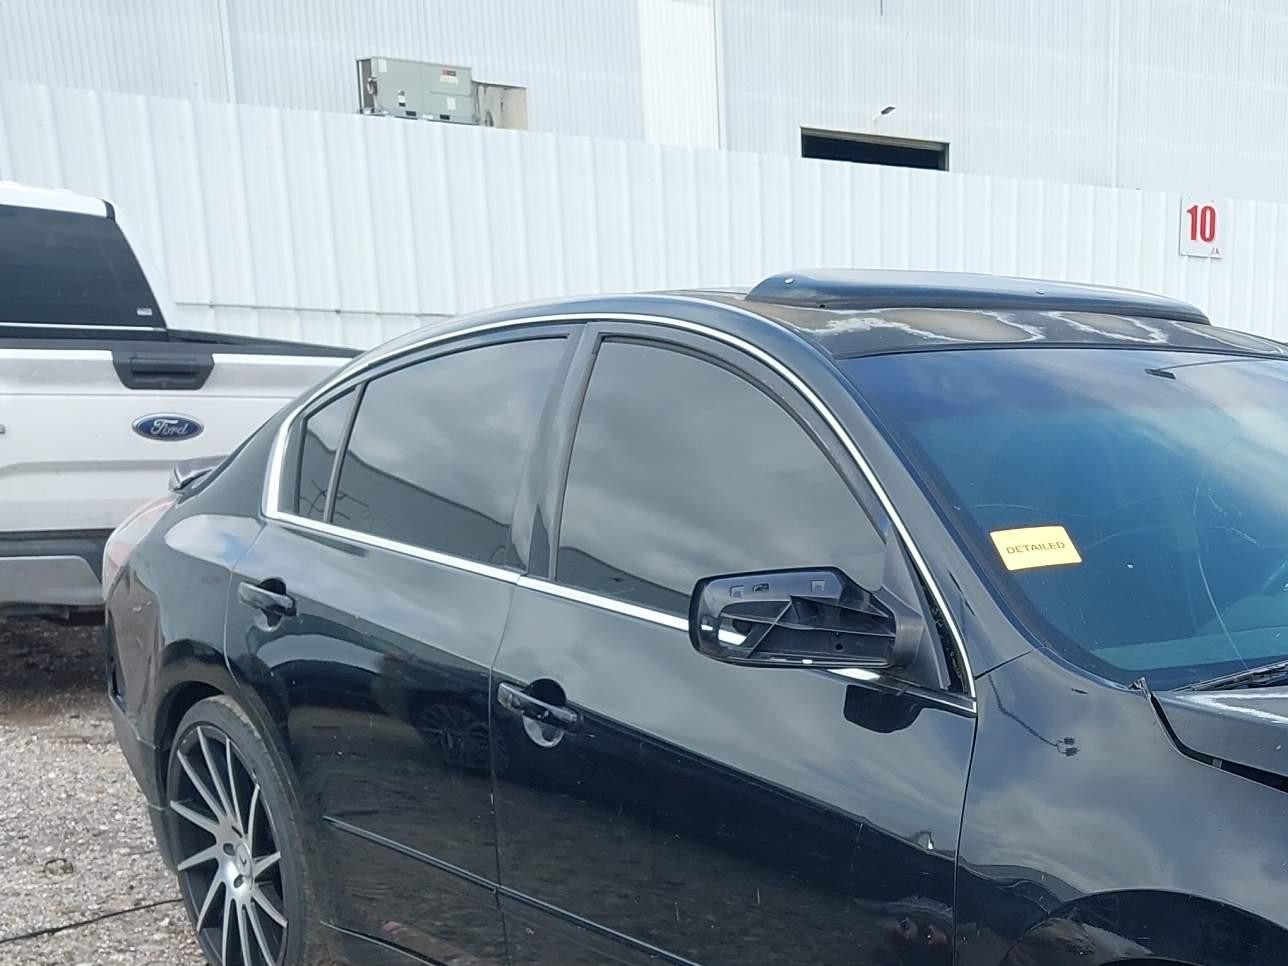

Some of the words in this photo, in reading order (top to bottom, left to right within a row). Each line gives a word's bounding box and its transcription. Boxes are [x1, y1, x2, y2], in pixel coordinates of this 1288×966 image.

[1186, 205, 1215, 242] 10
[150, 418, 189, 436] Ford
[1006, 541, 1066, 554] DETAILED
